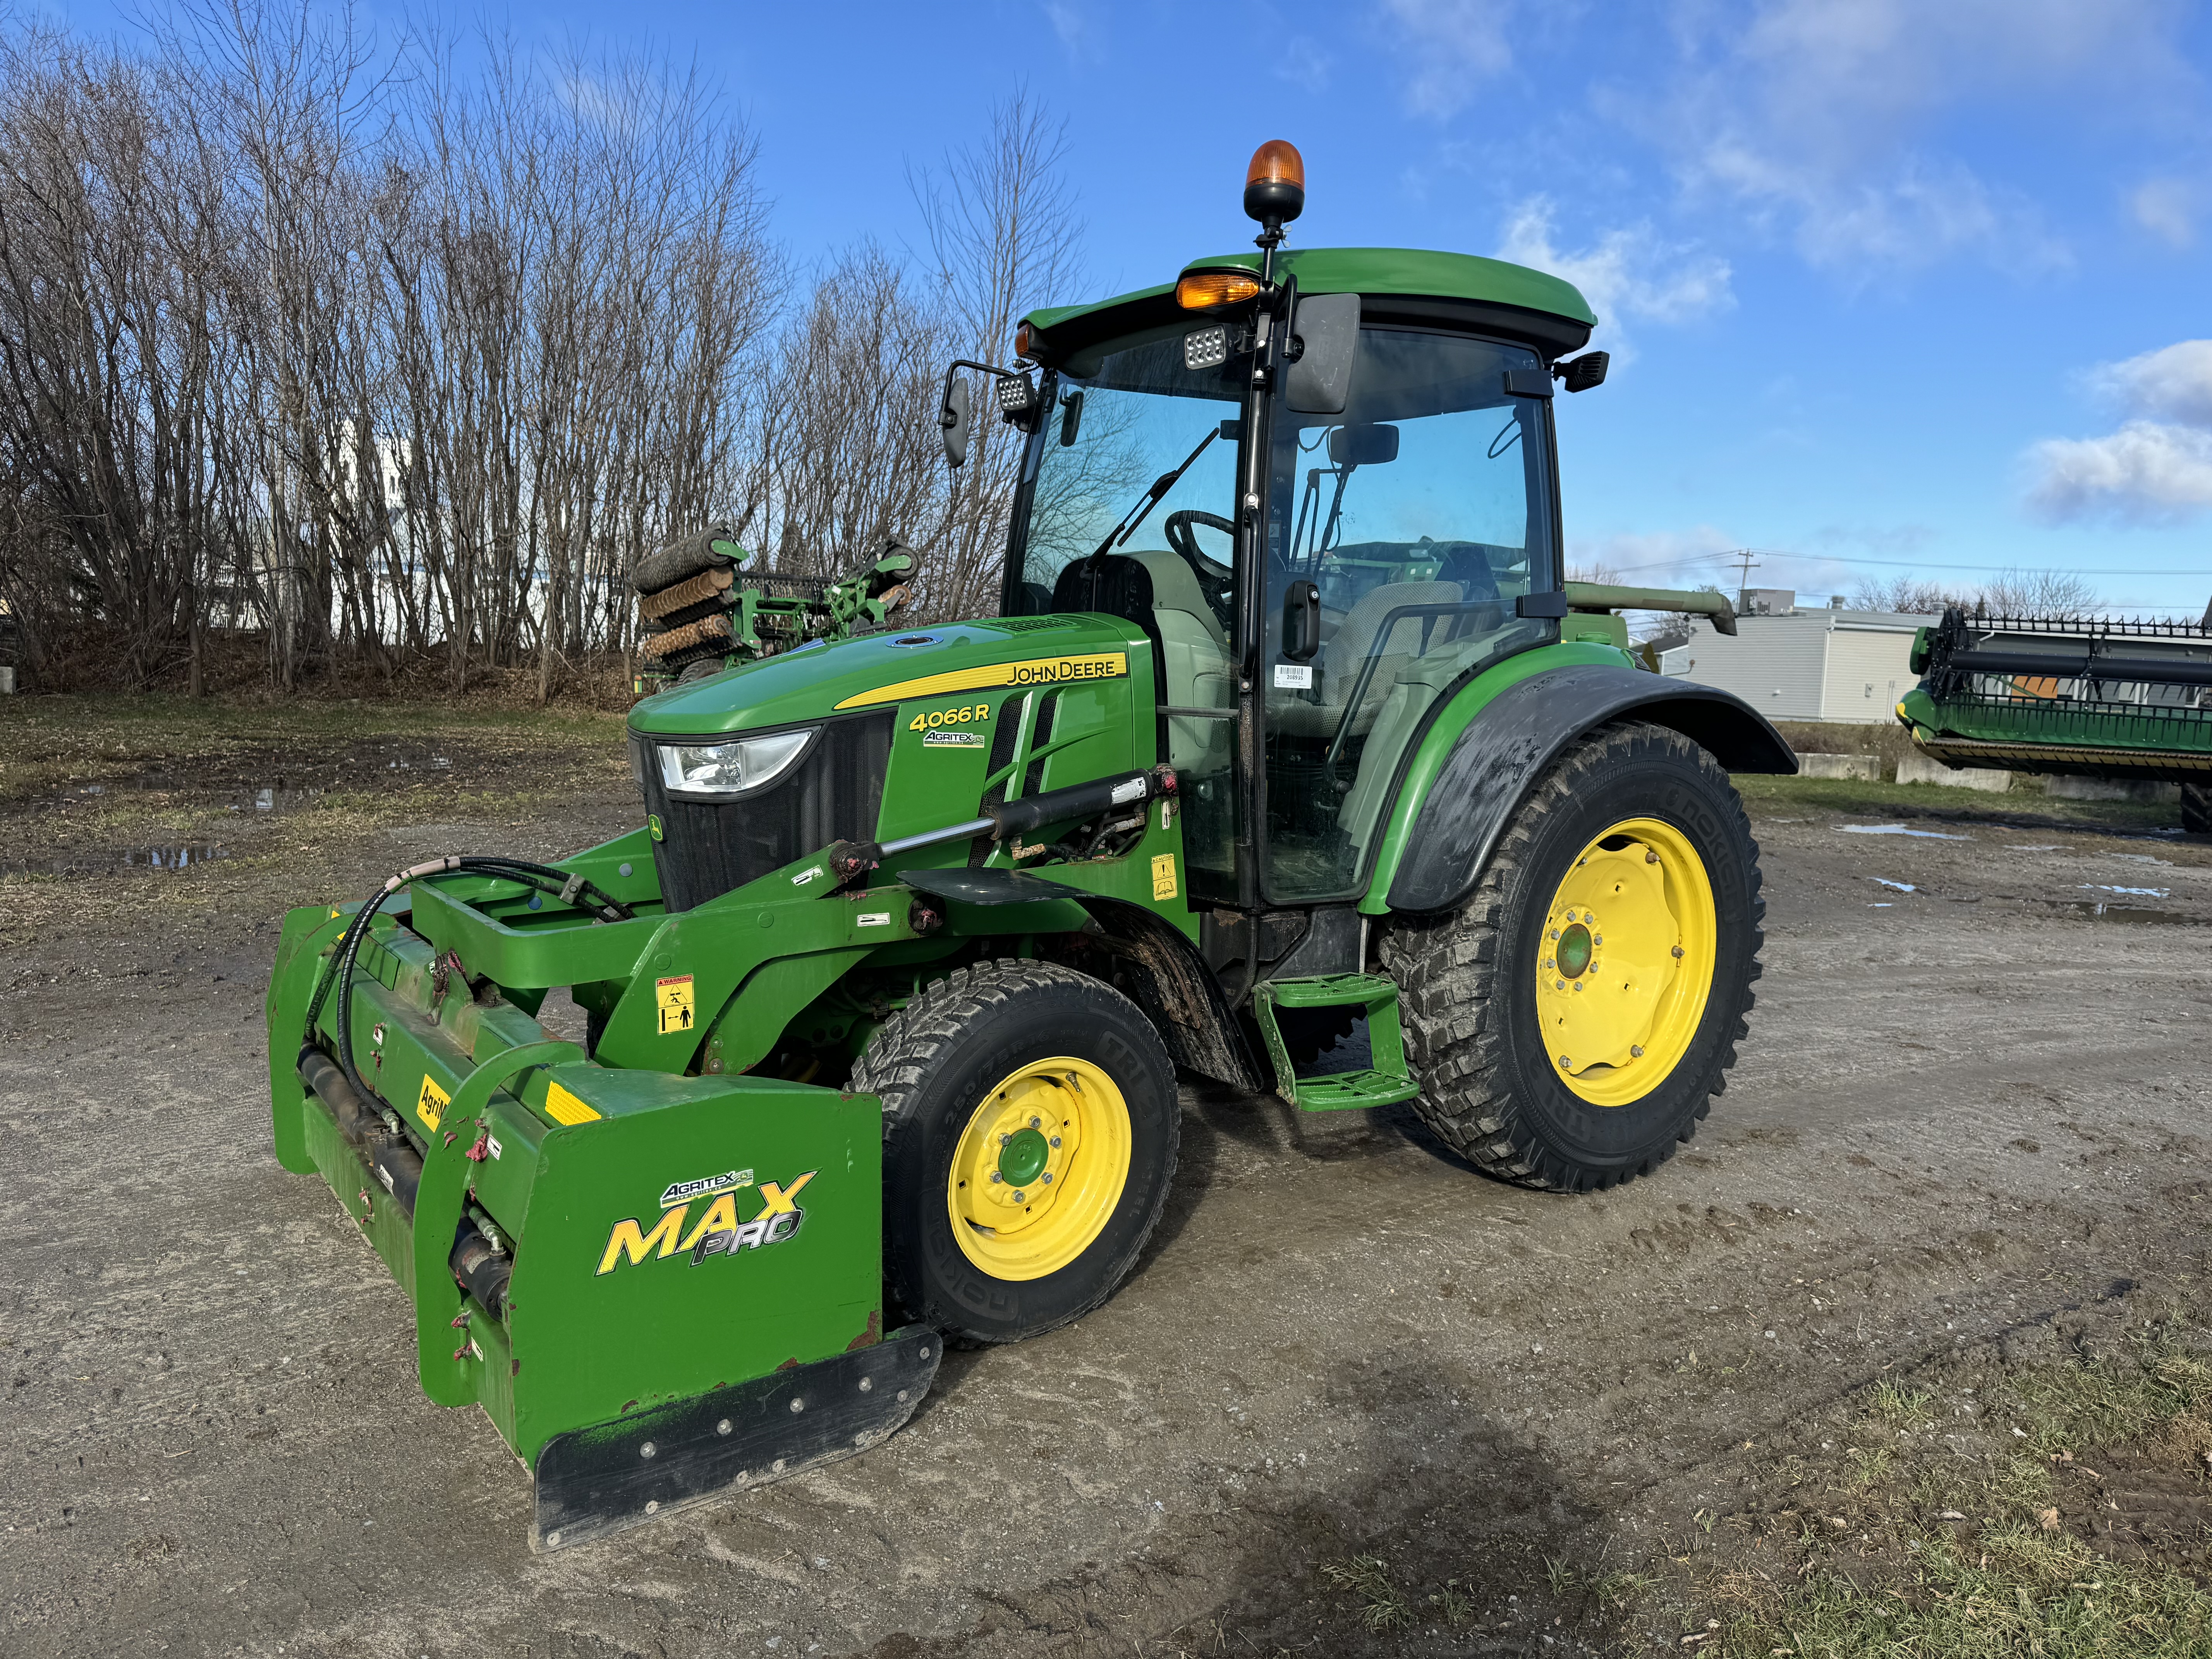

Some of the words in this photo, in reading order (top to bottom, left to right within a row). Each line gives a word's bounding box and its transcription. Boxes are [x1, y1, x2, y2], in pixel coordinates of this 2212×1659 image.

[1007, 665, 1056, 684] JOHN
[1059, 661, 1115, 678] DEERE
[909, 704, 990, 732] 4066R
[925, 732, 972, 741] AGRITEX
[664, 976, 691, 984] WARNING
[1104, 1037, 1147, 1086] TRI
[1545, 1086, 1585, 1137] TRI
[662, 1173, 735, 1199] AGRITEX
[594, 1167, 822, 1276] MAX
[689, 1209, 803, 1267] PRO
